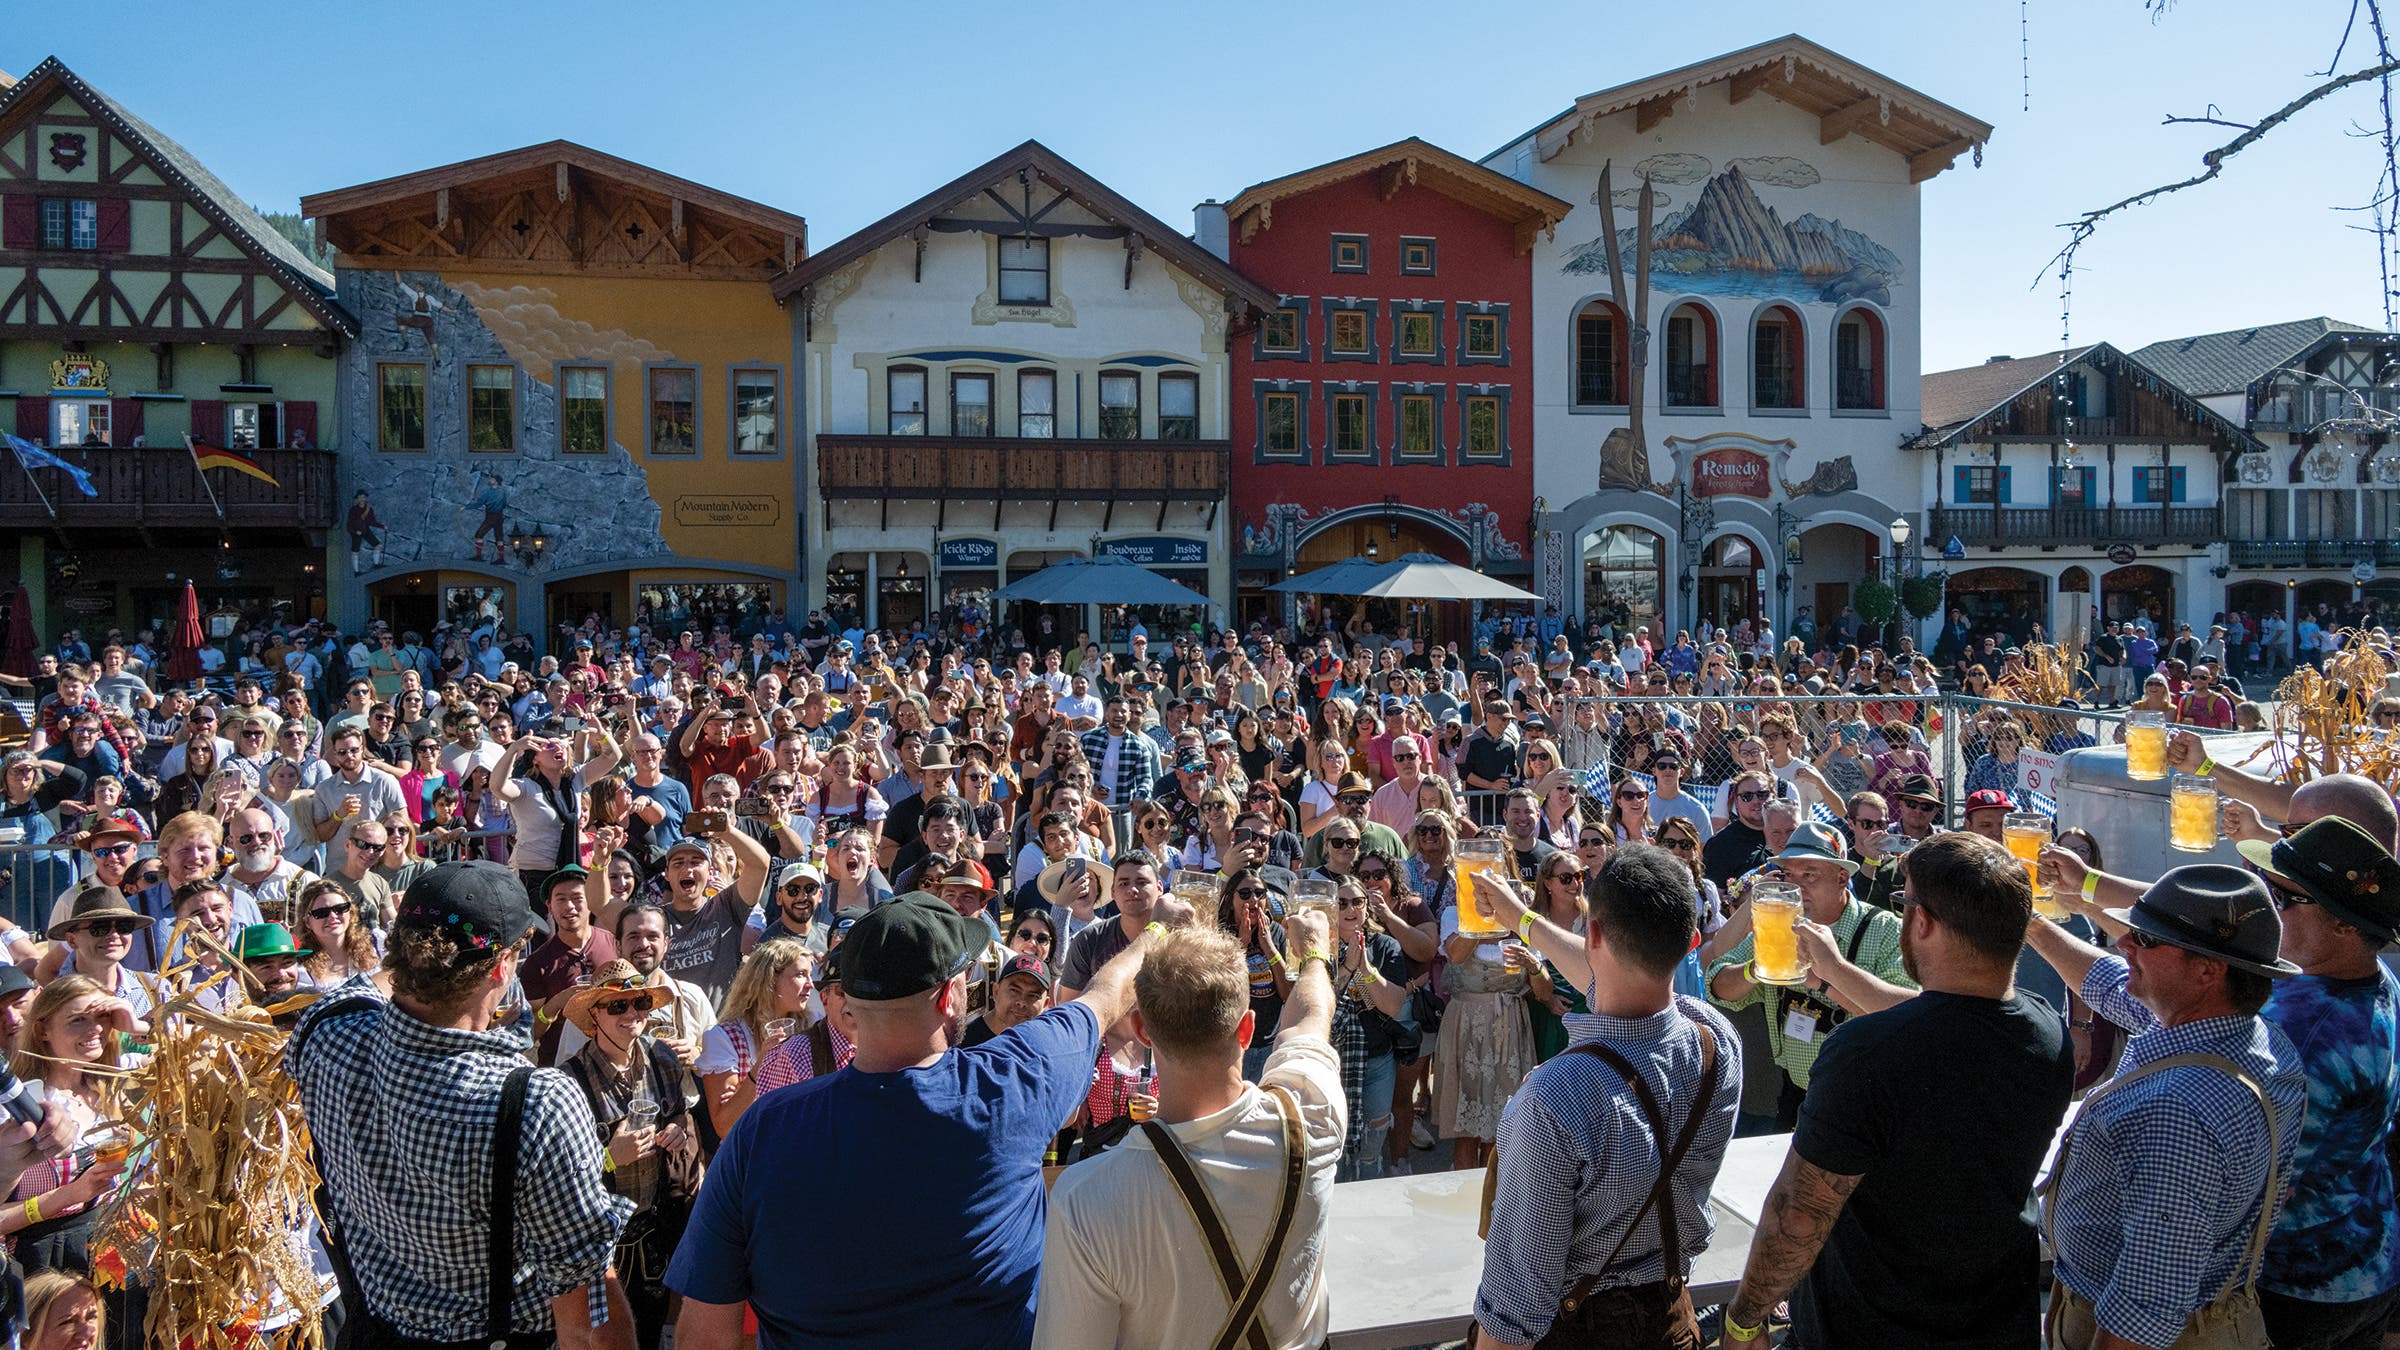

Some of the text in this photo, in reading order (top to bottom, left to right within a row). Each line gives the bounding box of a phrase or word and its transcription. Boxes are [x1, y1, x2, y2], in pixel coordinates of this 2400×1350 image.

[1702, 460, 1760, 480] Remedy
[681, 501, 770, 512] Mountain Modern
[944, 543, 994, 556] Icicle Ridge
[1106, 544, 1154, 555] Boudreaux
[1175, 543, 1201, 554] Inside
[957, 554, 981, 562] Winery
[2020, 753, 2056, 769] no smo
[668, 921, 720, 951] uengling
[663, 950, 714, 972] LAGER
